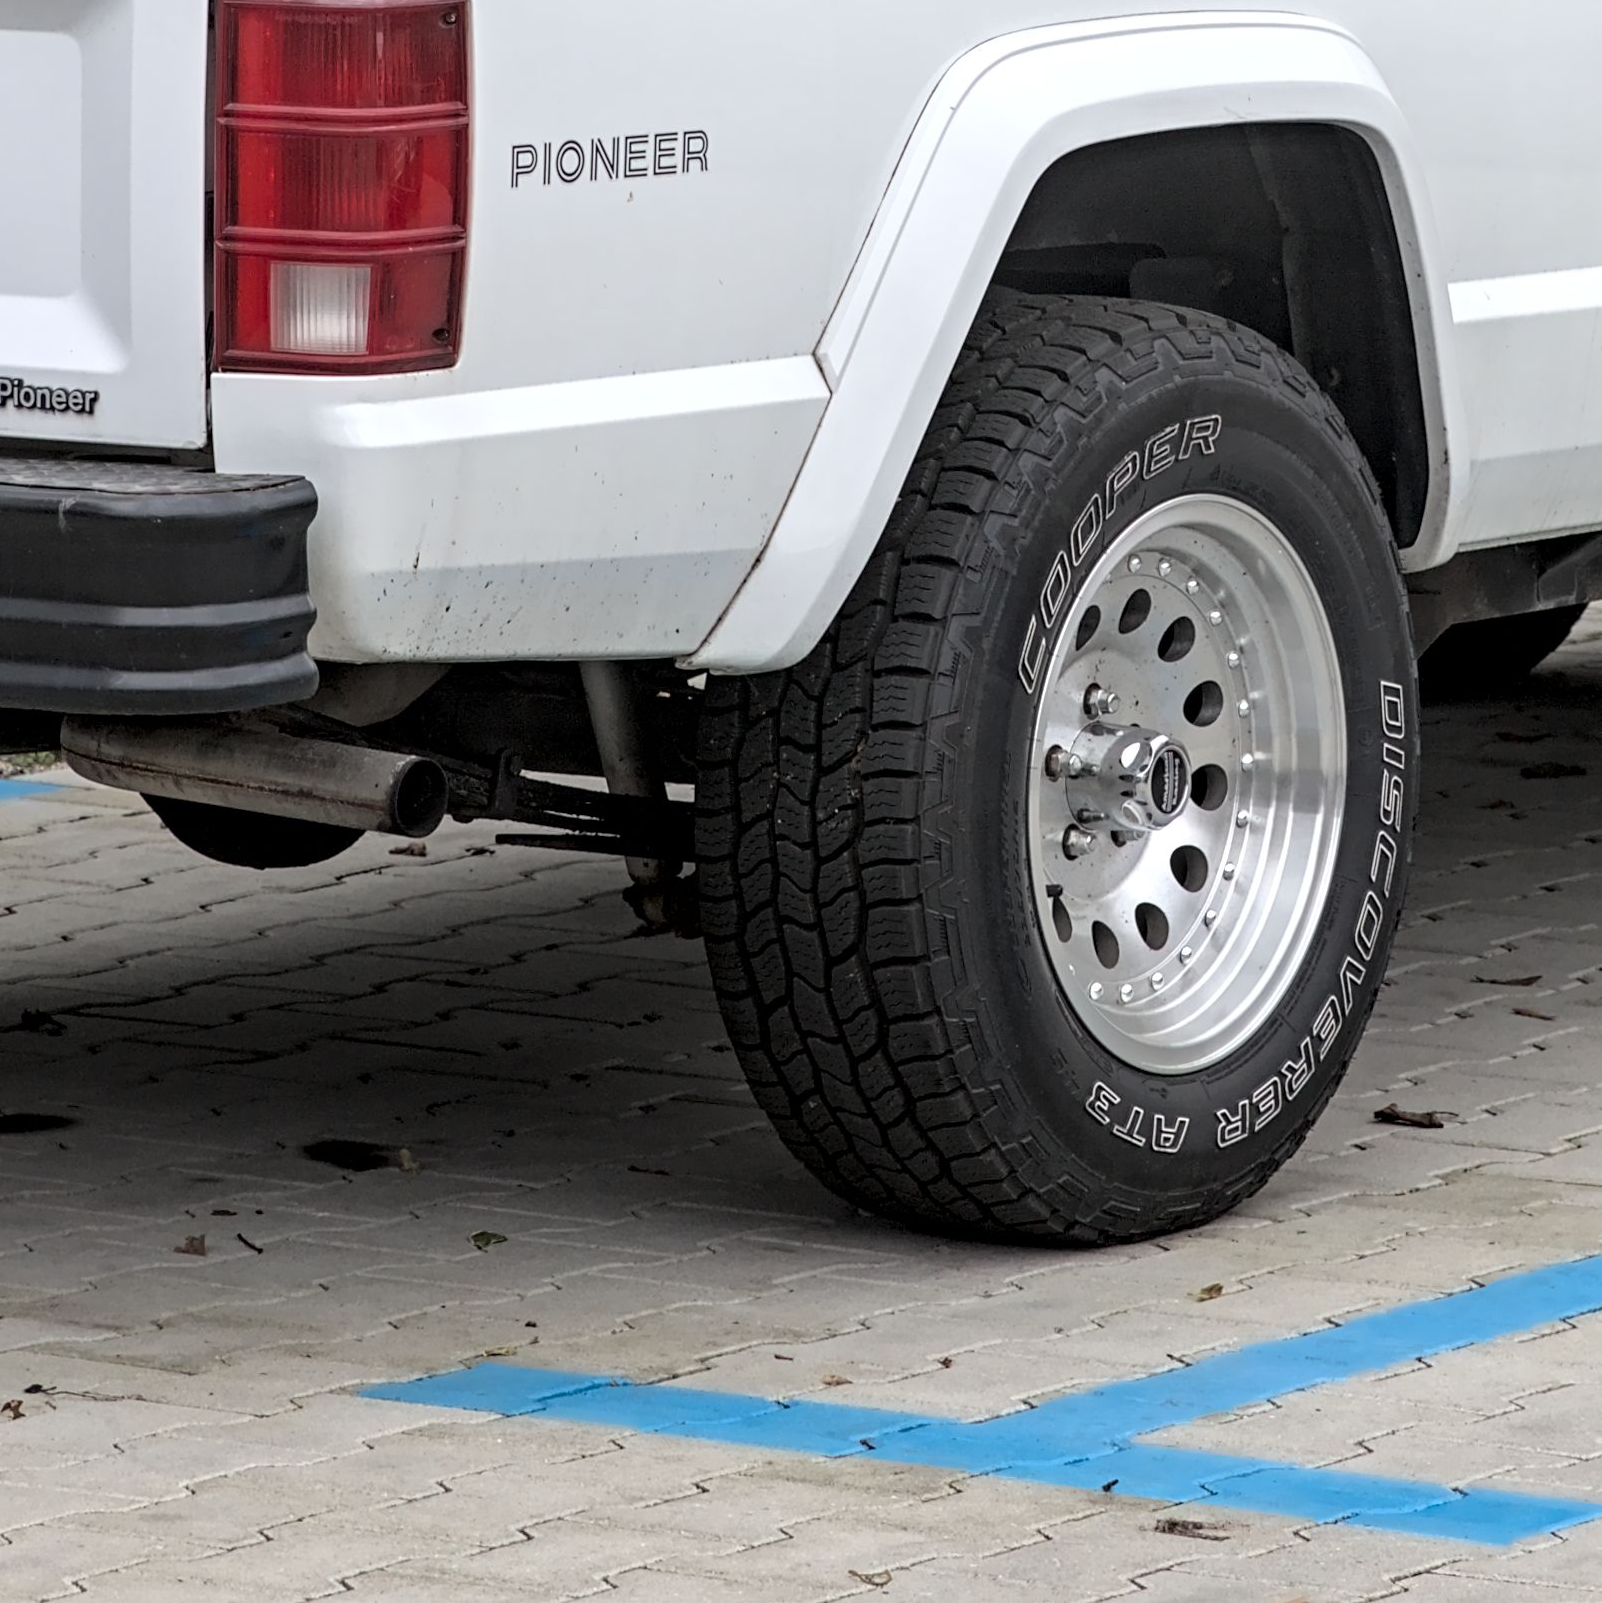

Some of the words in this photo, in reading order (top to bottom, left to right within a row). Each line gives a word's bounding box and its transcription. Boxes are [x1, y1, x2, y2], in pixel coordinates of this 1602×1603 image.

[511, 129, 710, 189] PIONEER
[1018, 413, 1223, 695] COOPER
[1215, 680, 1404, 1149] DISCOVERER
[1085, 1081, 1190, 1153] AT3
